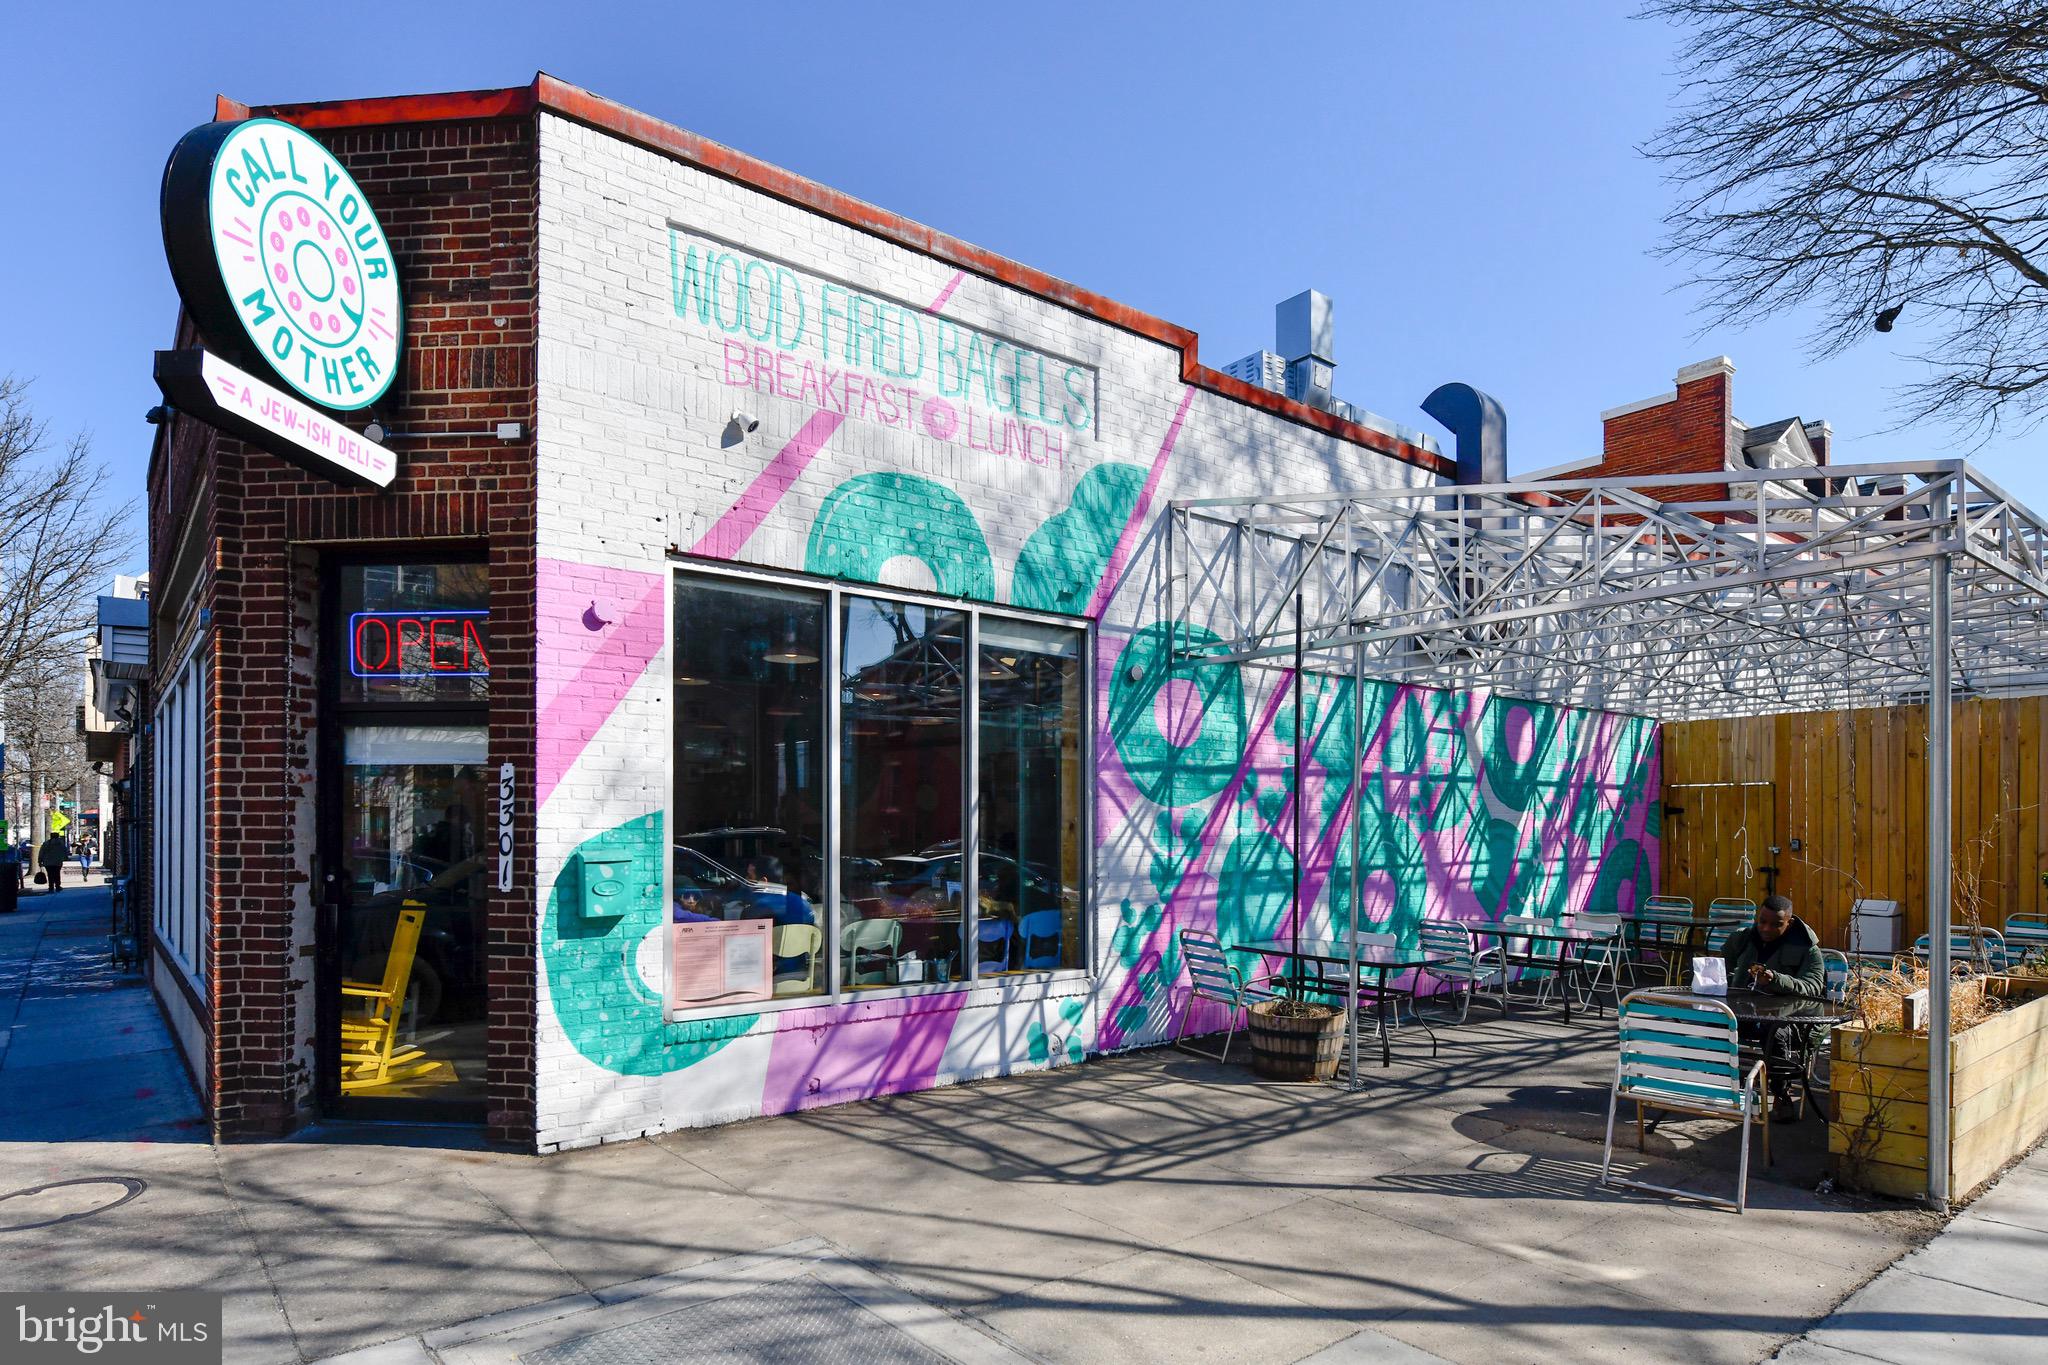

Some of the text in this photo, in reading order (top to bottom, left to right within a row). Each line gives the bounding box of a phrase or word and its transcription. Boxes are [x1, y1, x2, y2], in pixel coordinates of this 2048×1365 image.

[226, 137, 389, 280] CALL YOUR
[242, 288, 381, 396] MOTHER
[668, 227, 1092, 431] WOOD FIRED BAGELS
[240, 386, 369, 467] A JEW-ISH DELI
[723, 337, 1064, 470] BREAKFAST LUNCH
[355, 618, 491, 671] OPEN
[499, 776, 514, 887] 3301
